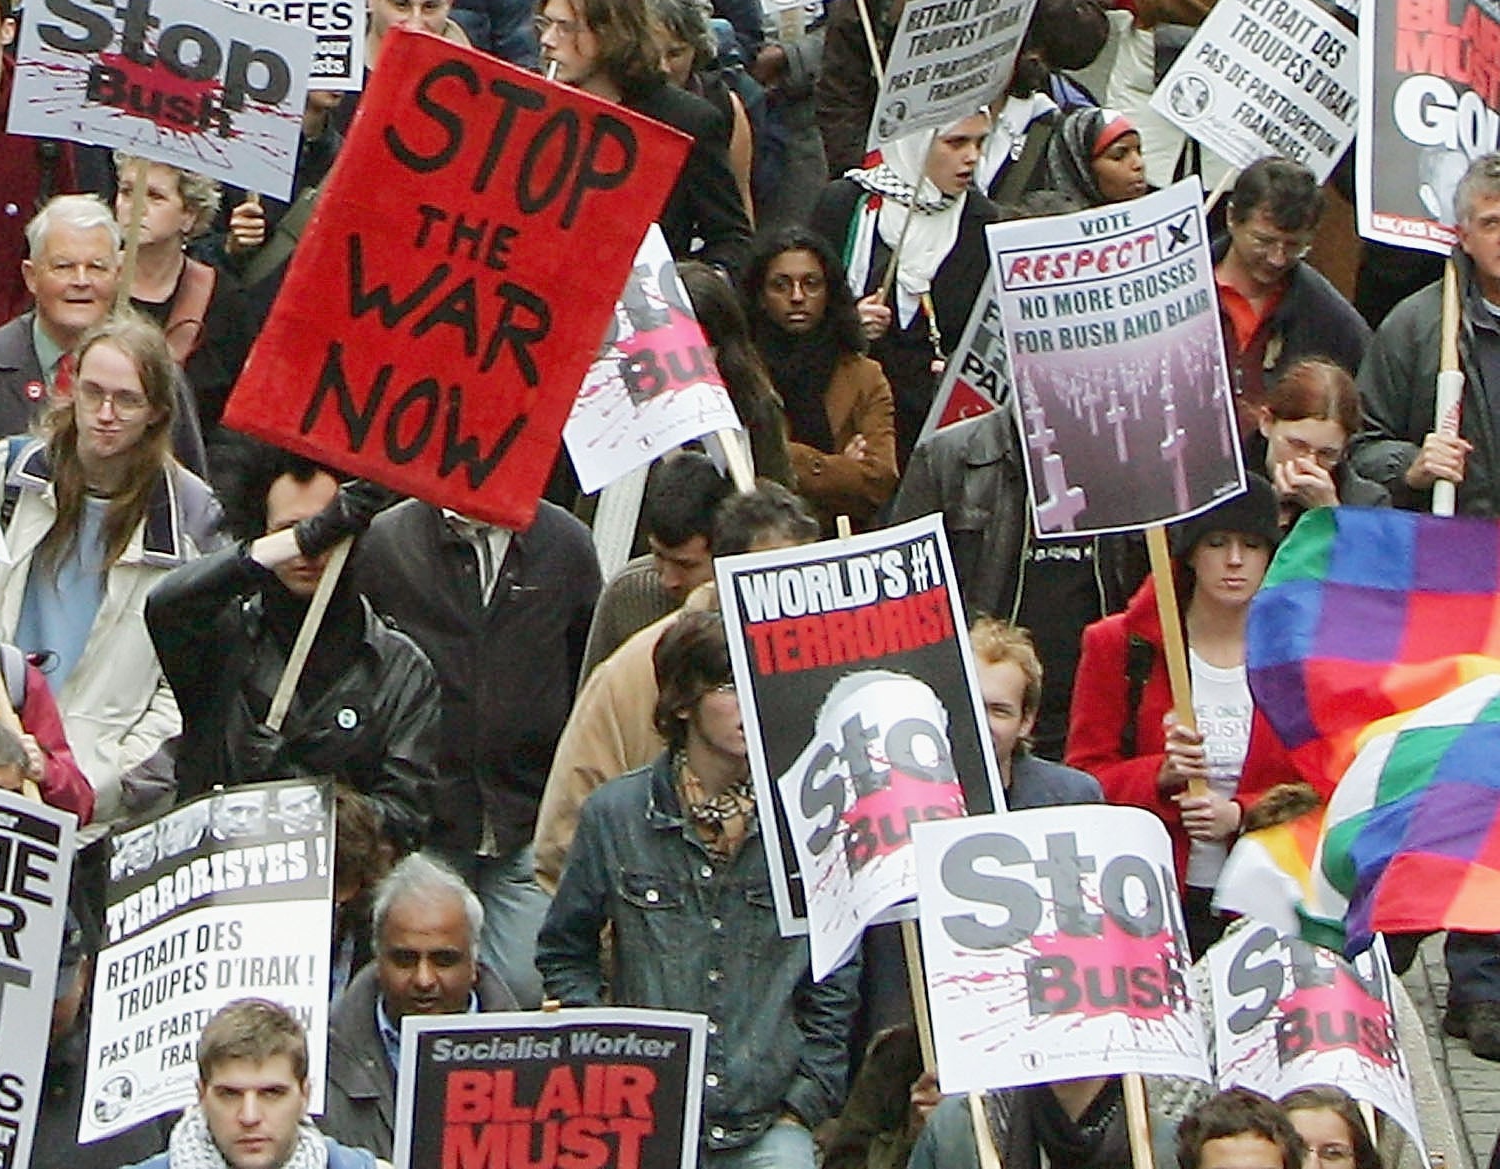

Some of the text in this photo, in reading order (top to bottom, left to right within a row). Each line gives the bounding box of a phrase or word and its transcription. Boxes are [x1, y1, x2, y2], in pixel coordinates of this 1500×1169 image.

[1312, 32, 1347, 69] DES
[384, 58, 638, 230] STOP
[413, 204, 521, 271] THE
[1079, 210, 1132, 237] VOTE
[1005, 233, 1156, 284] RESPECT
[1019, 260, 1198, 320] NO MORE CROSSES
[348, 235, 553, 388] WAR
[1014, 287, 1212, 355] FOR BUSH AND BLAIR
[301, 339, 528, 491] NOW
[739, 540, 942, 624] WORLD'S #1
[746, 585, 955, 676] TERRORIST
[106, 840, 312, 944] TERRORISTES
[107, 920, 244, 992] RETRAIT DES
[431, 1033, 677, 1064] Socialist Worker
[443, 1064, 657, 1126] BLAIR
[442, 1118, 655, 1169] MUST
